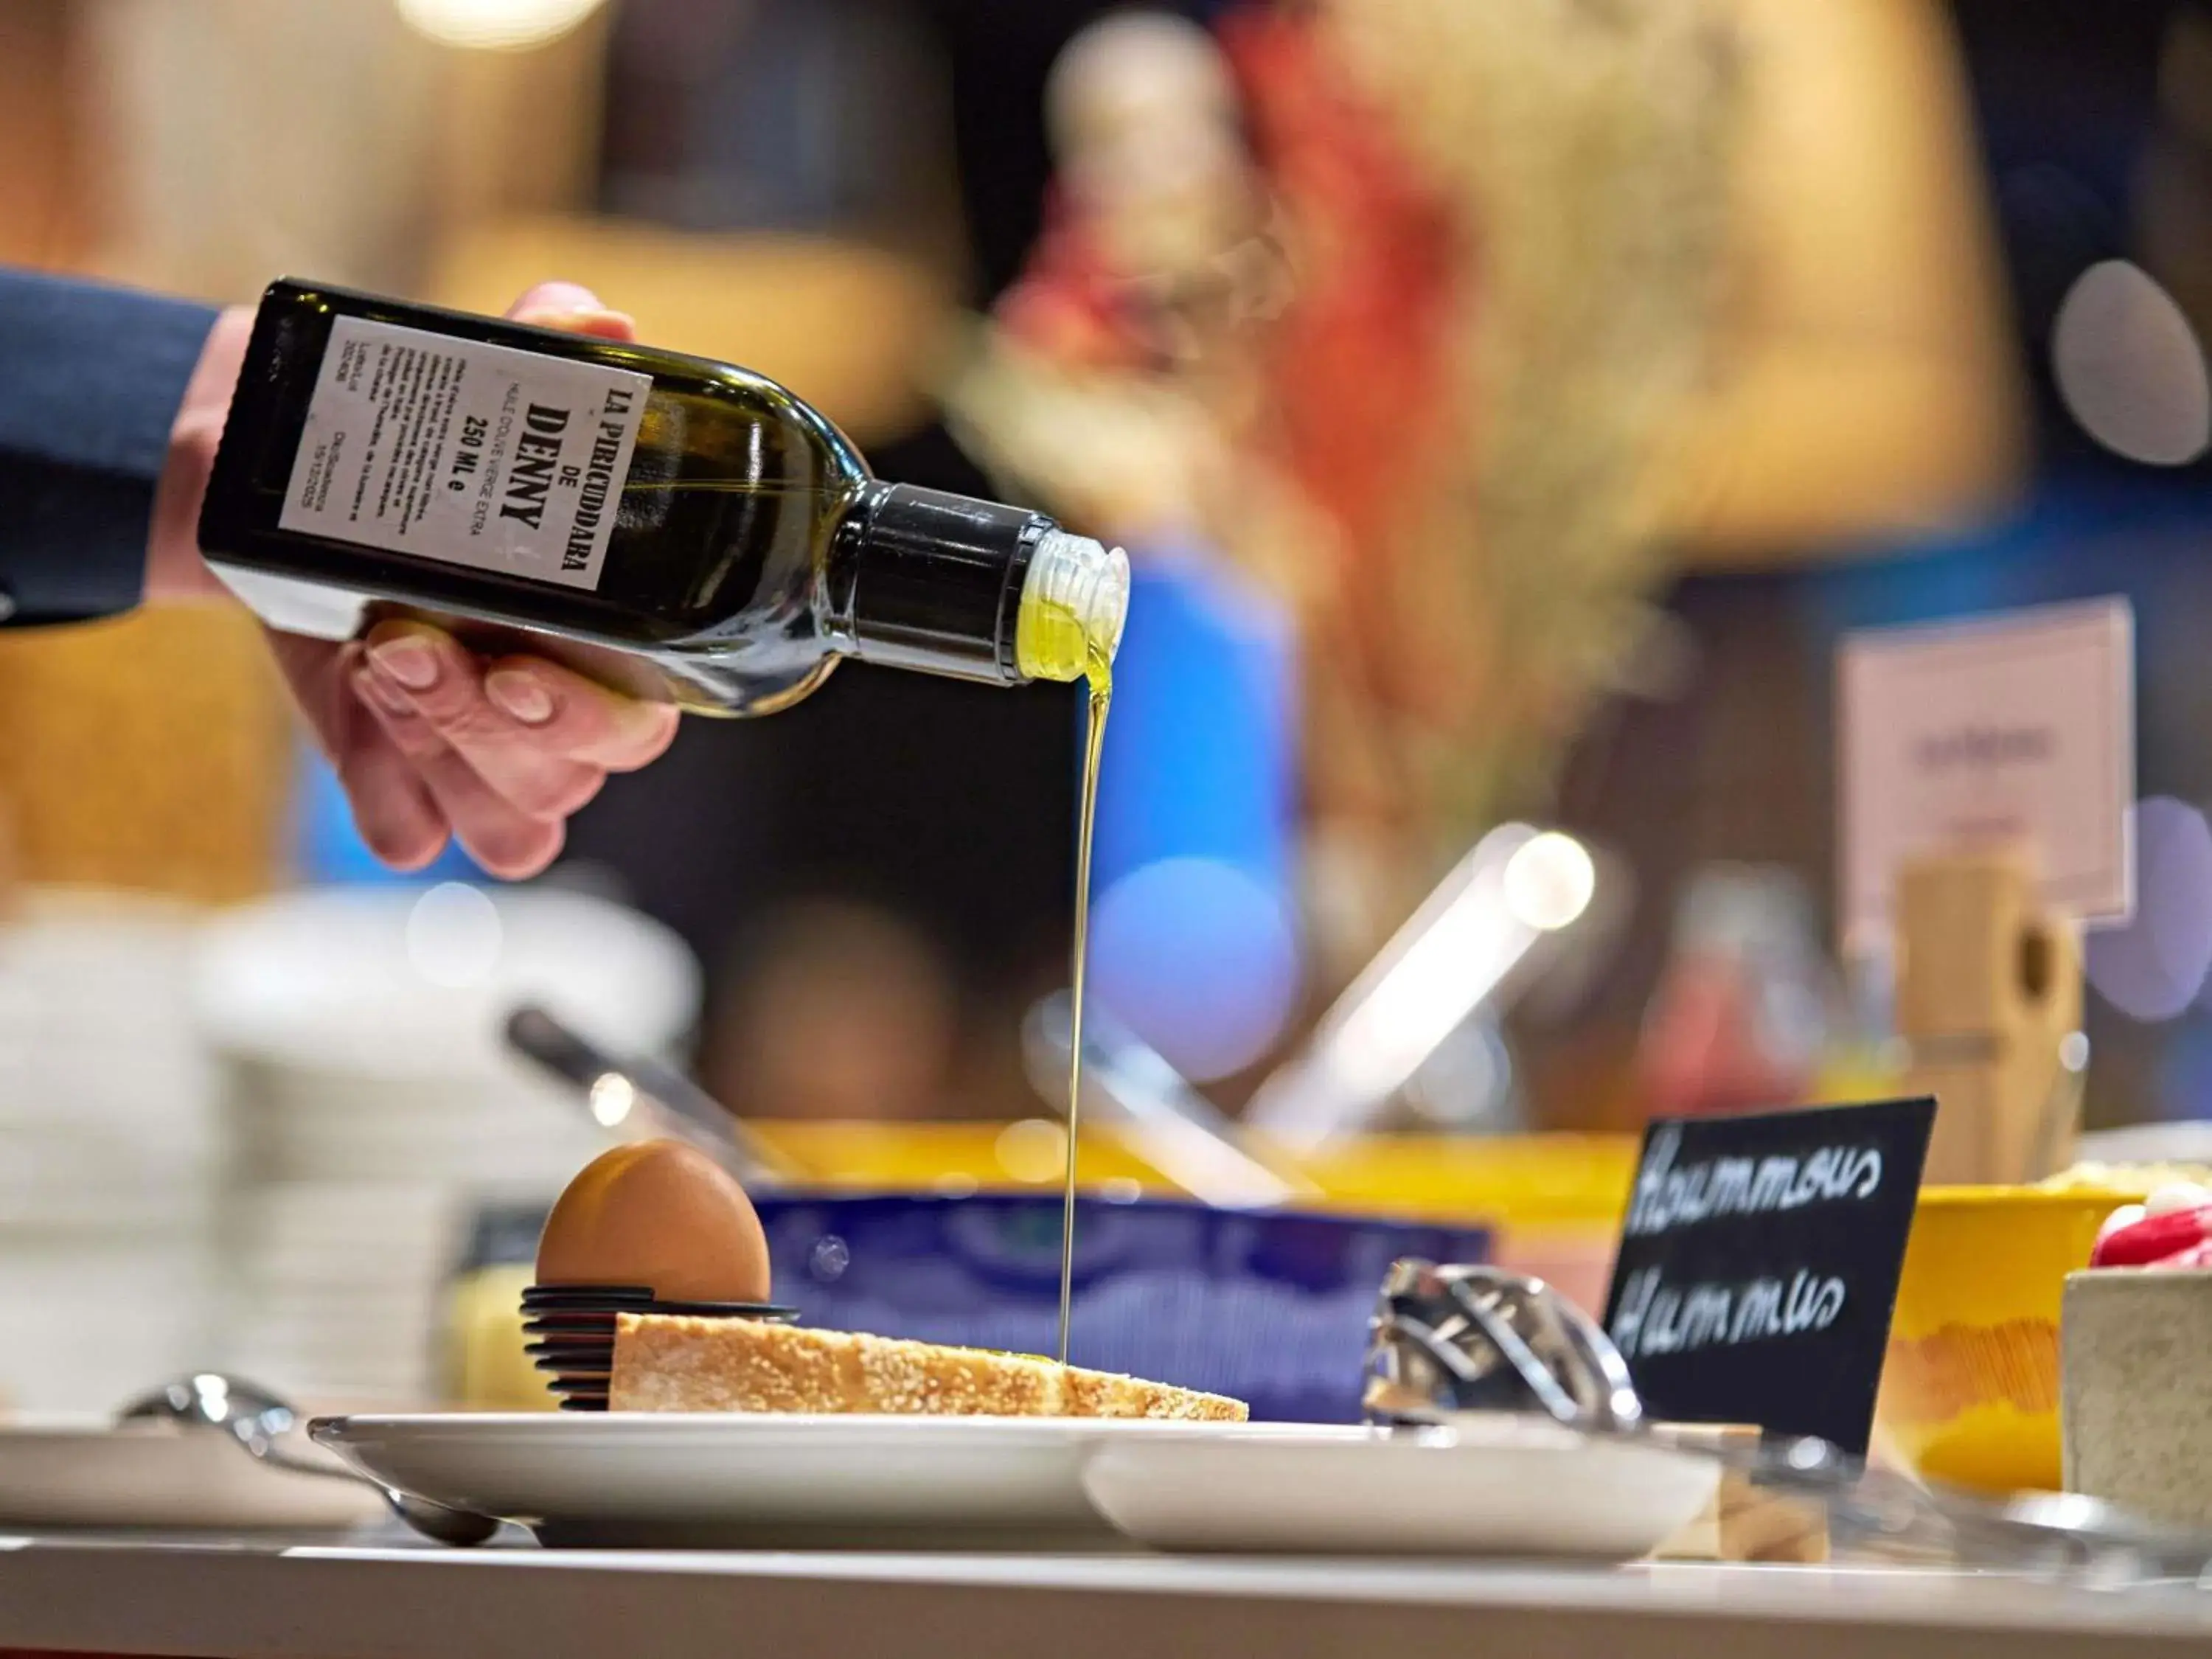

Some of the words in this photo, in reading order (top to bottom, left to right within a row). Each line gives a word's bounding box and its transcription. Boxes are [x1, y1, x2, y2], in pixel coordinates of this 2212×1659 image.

[501, 382, 521, 414] HUILE
[603, 388, 633, 414] LA
[459, 414, 488, 448] 250
[451, 450, 479, 475] ML
[478, 458, 500, 498] VIERGE
[498, 402, 570, 530] DENNY
[557, 465, 581, 488] DE
[560, 420, 625, 571] PIRICUDDARA
[469, 500, 489, 536] EXTRA
